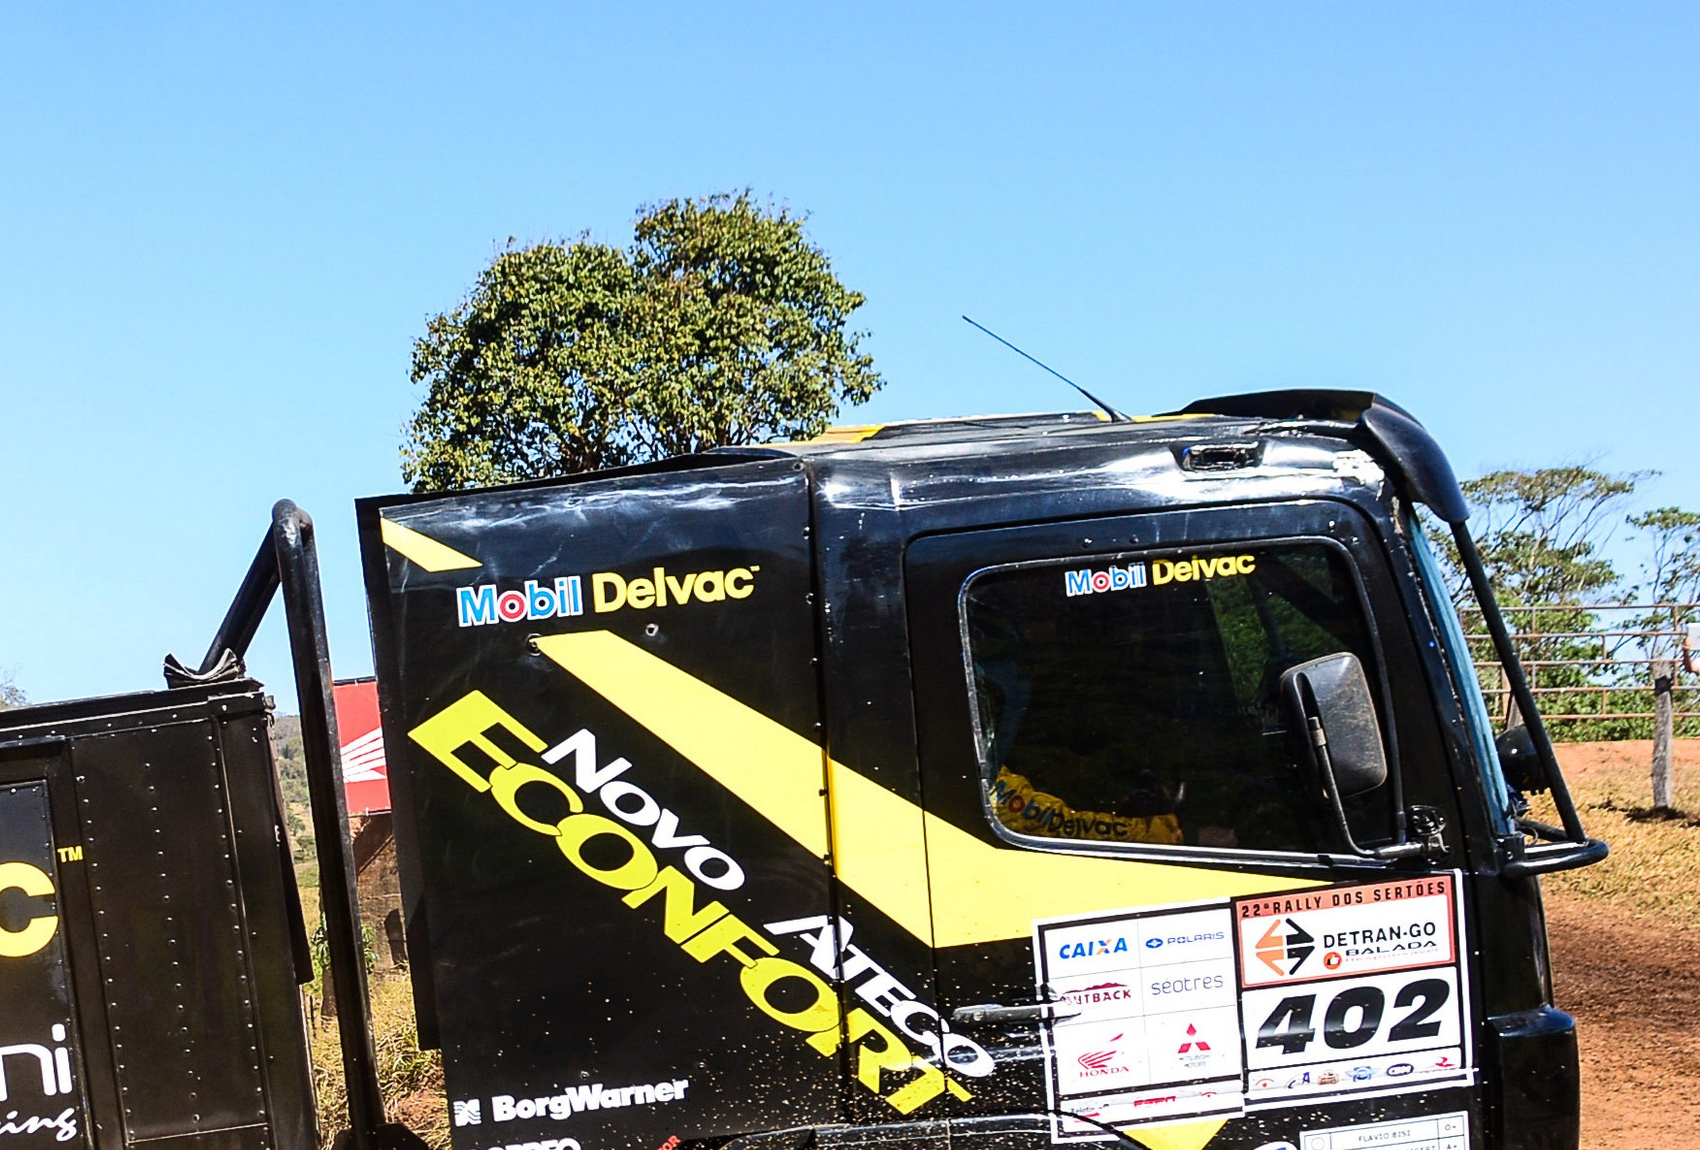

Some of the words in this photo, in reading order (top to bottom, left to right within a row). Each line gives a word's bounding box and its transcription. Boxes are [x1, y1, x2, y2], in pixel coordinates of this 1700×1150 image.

[456, 575, 584, 627] Mobil
[592, 566, 756, 613] Delvac
[1065, 562, 1147, 597] Mobil
[1152, 555, 1256, 586] Delvac
[407, 689, 973, 1116] ECONFORT
[1273, 896, 1322, 914] RALLY
[1332, 891, 1363, 907] DOS
[1373, 880, 1446, 902] SERTÕES
[1059, 937, 1129, 959] CAIXA
[1167, 931, 1225, 945] POLARIS
[1323, 921, 1437, 949] DETRAN-GO
[1345, 940, 1437, 956] BALADA
[763, 914, 996, 1078] ATEGO
[1255, 978, 1451, 1055] 402
[1079, 1066, 1130, 1078] HONDA
[491, 1079, 690, 1122] BorgWarner
